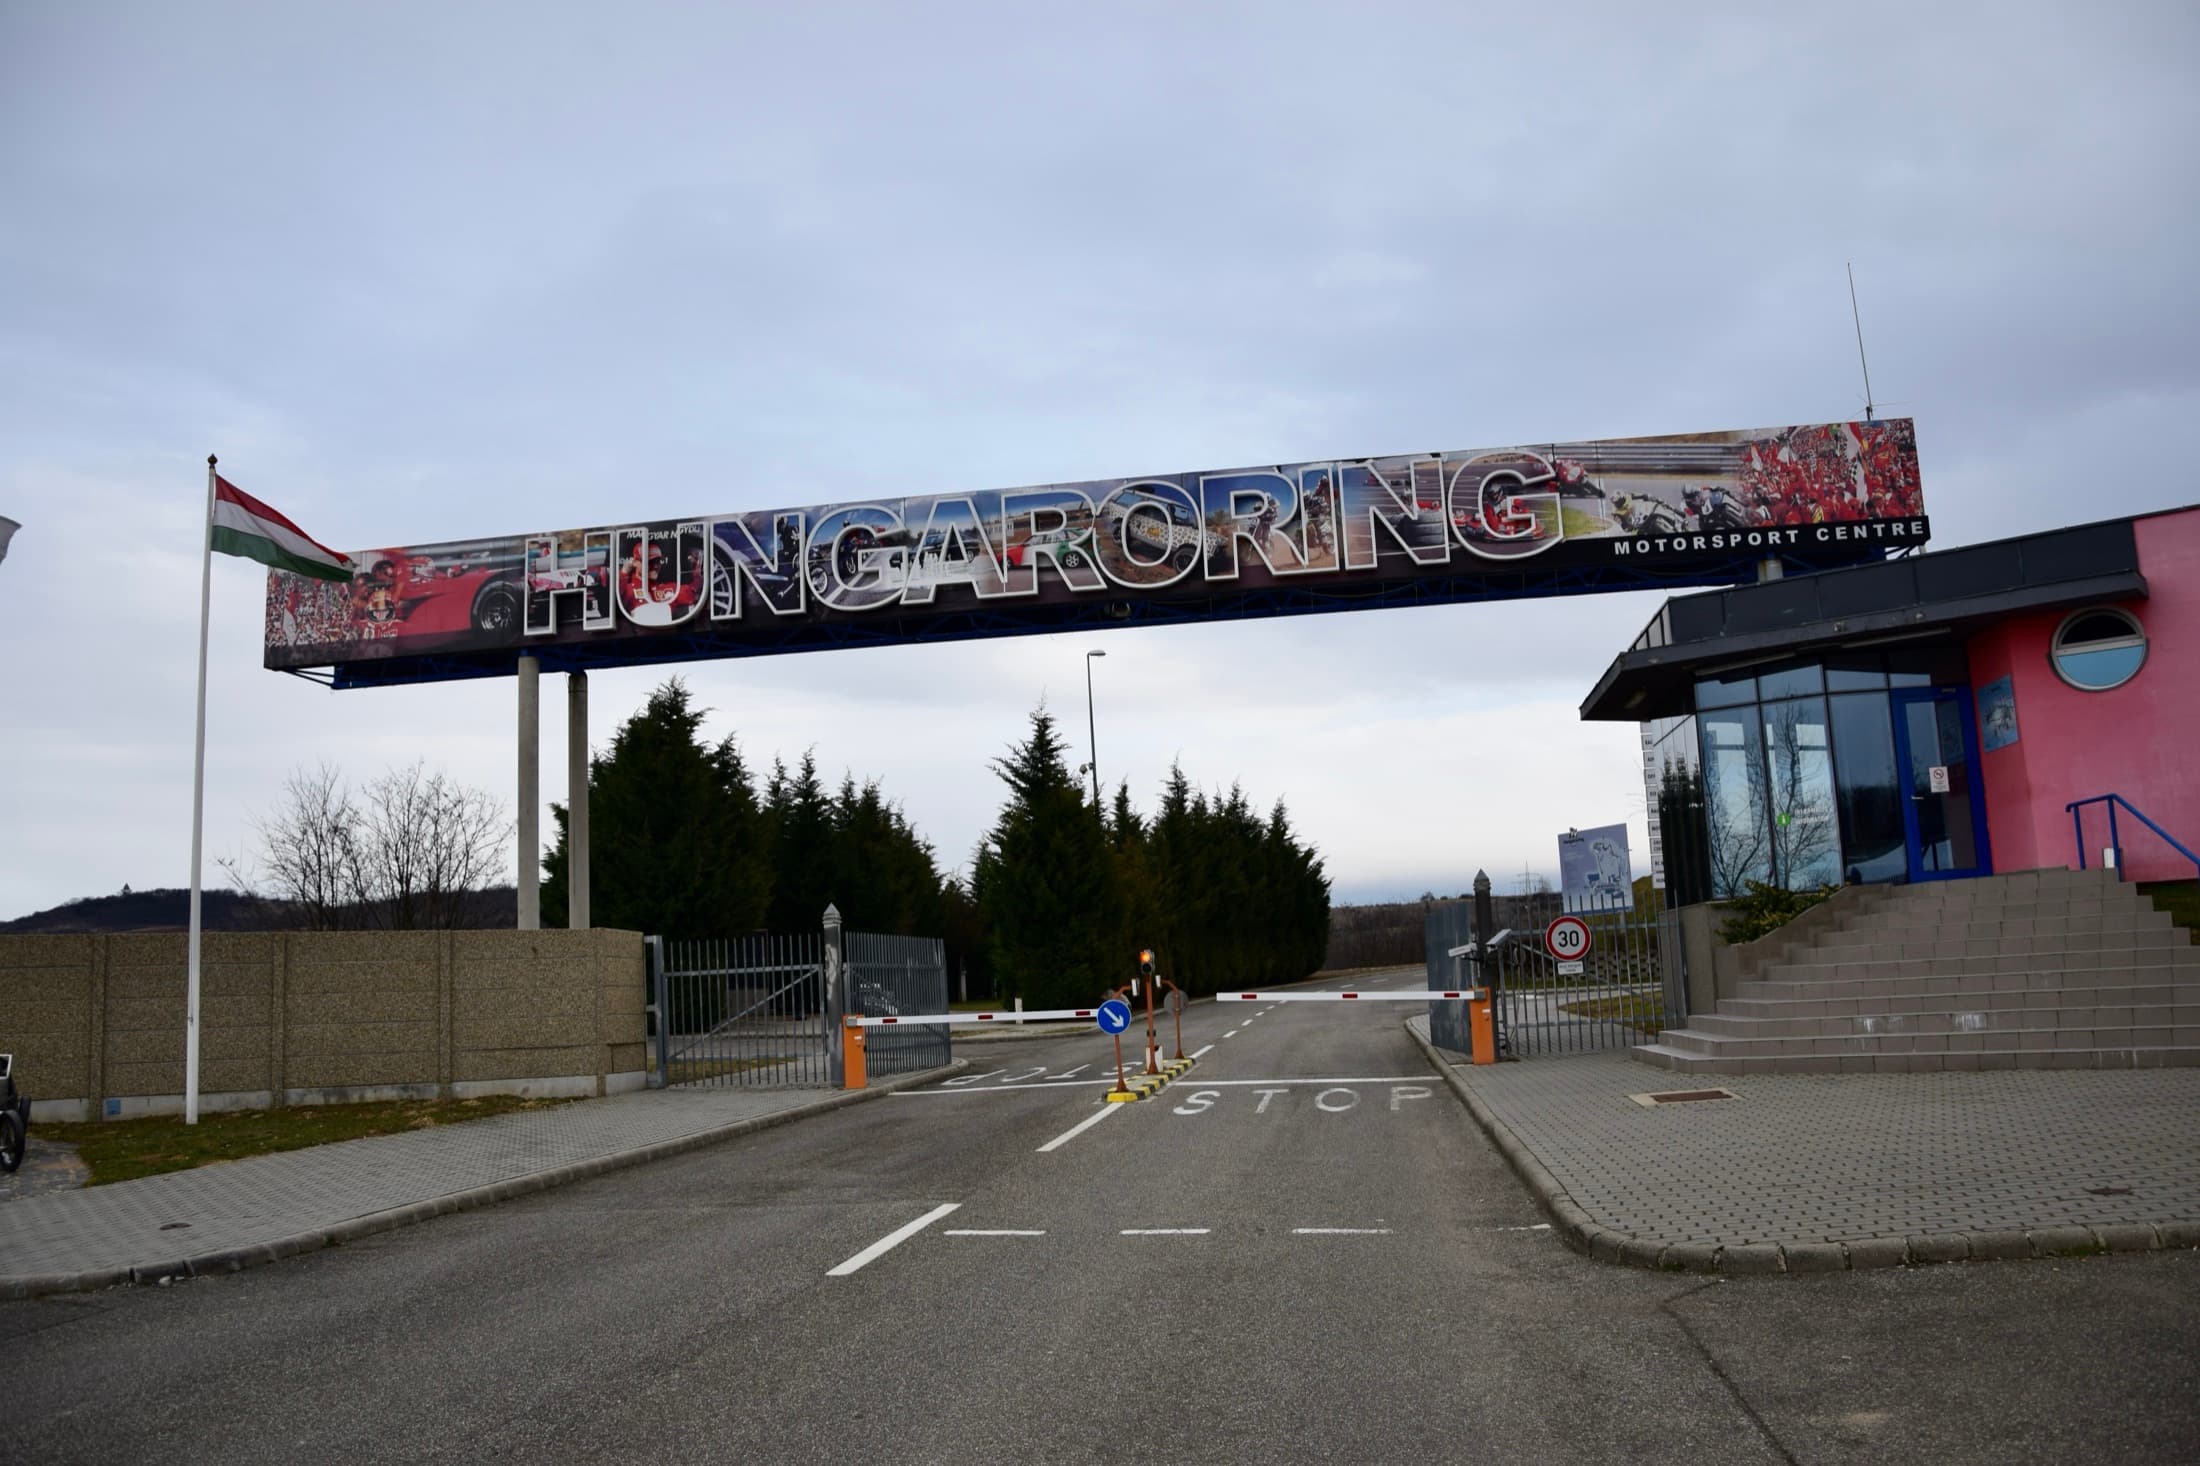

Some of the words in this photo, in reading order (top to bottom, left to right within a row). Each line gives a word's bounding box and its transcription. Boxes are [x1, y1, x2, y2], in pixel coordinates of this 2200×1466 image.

[525, 449, 1564, 635] HUNGARORING
[1615, 530, 1799, 555] MOTORSPORT
[1815, 520, 1925, 542] CENTRE
[1558, 930, 1580, 948] 30
[1172, 1086, 1435, 1115] STOP
